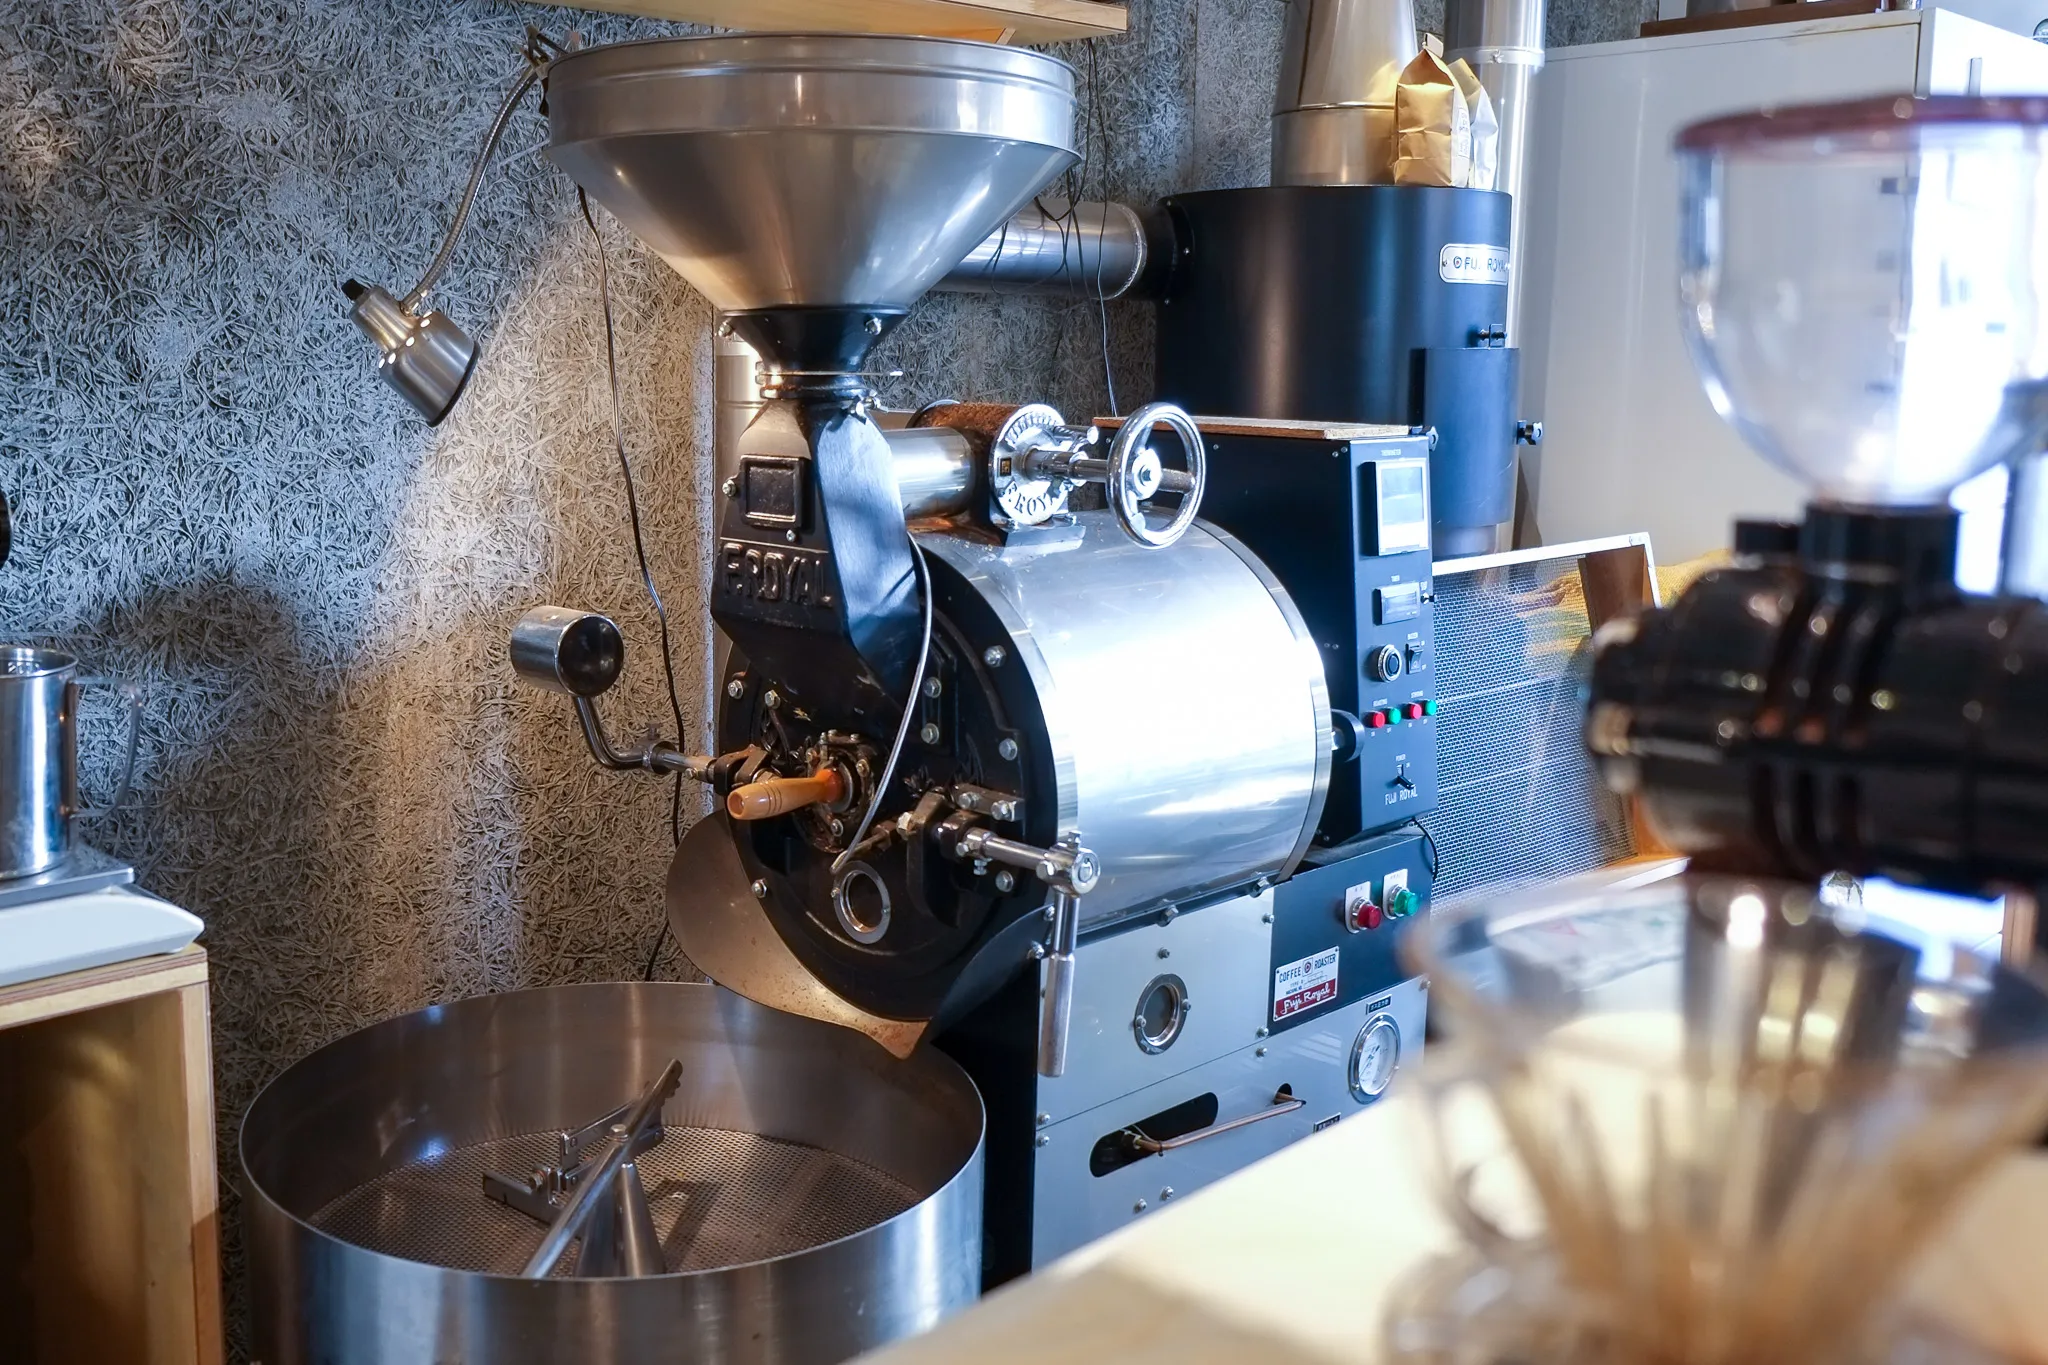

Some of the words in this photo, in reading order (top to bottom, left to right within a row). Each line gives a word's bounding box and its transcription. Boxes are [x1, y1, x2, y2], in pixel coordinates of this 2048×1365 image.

[1385, 792, 1397, 805] FUJI
[1399, 786, 1418, 800] ROYAL
[1279, 967, 1301, 983] COFFEE
[1314, 954, 1336, 970] ROASTER
[1280, 995, 1303, 1015] Fuji
[1304, 982, 1330, 1001] Royal
